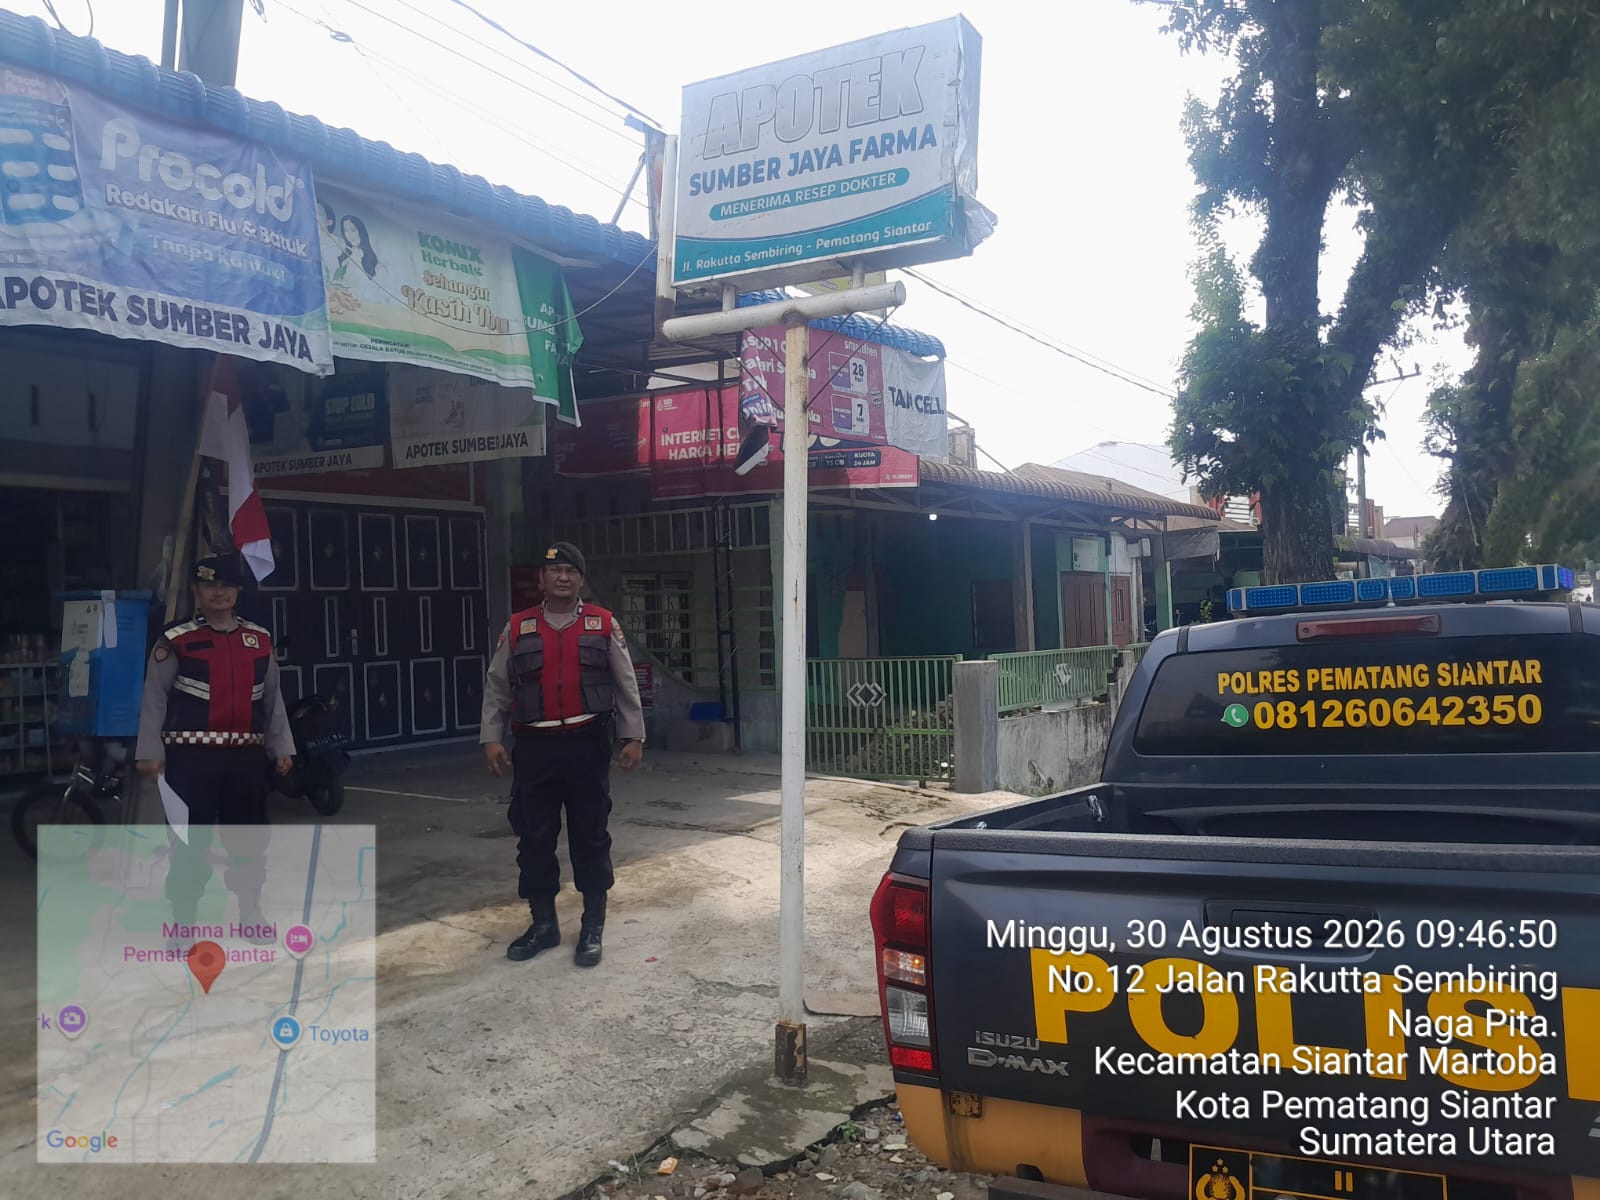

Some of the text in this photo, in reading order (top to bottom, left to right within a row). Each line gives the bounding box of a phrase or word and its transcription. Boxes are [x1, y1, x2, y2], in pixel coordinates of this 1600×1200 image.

[703, 45, 926, 160] APOTEK
[101, 118, 297, 222] Procold
[689, 123, 937, 197] SUMBER JAYA FARMA
[720, 172, 897, 217] MENERIMA RESEP DOKTER
[106, 183, 308, 258] Redakan Flu & Batuk
[417, 231, 485, 264] KOMIX
[682, 260, 693, 272] Jl.
[744, 244, 803, 262] Sembiring
[816, 231, 880, 250] Pematang
[884, 221, 932, 238] Siantar
[0, 276, 314, 364] POTEK SUMBER JAYA
[401, 284, 510, 333] Kasih Ibu
[852, 362, 865, 377] 28
[857, 403, 864, 417] 7
[914, 394, 944, 415] CELL
[405, 442, 449, 460] APOTEK
[501, 432, 529, 450] JAYA
[661, 428, 723, 447] INTERNET
[669, 444, 712, 461] HARGA
[254, 453, 353, 473] APOTEK SUMBER JAYA
[1217, 658, 1544, 696] POLRES PEMATANG SIANTAR
[1253, 693, 1543, 730] 081260642350
[974, 1030, 1040, 1051] ISUZU
[967, 1047, 1069, 1077] D-MAX
